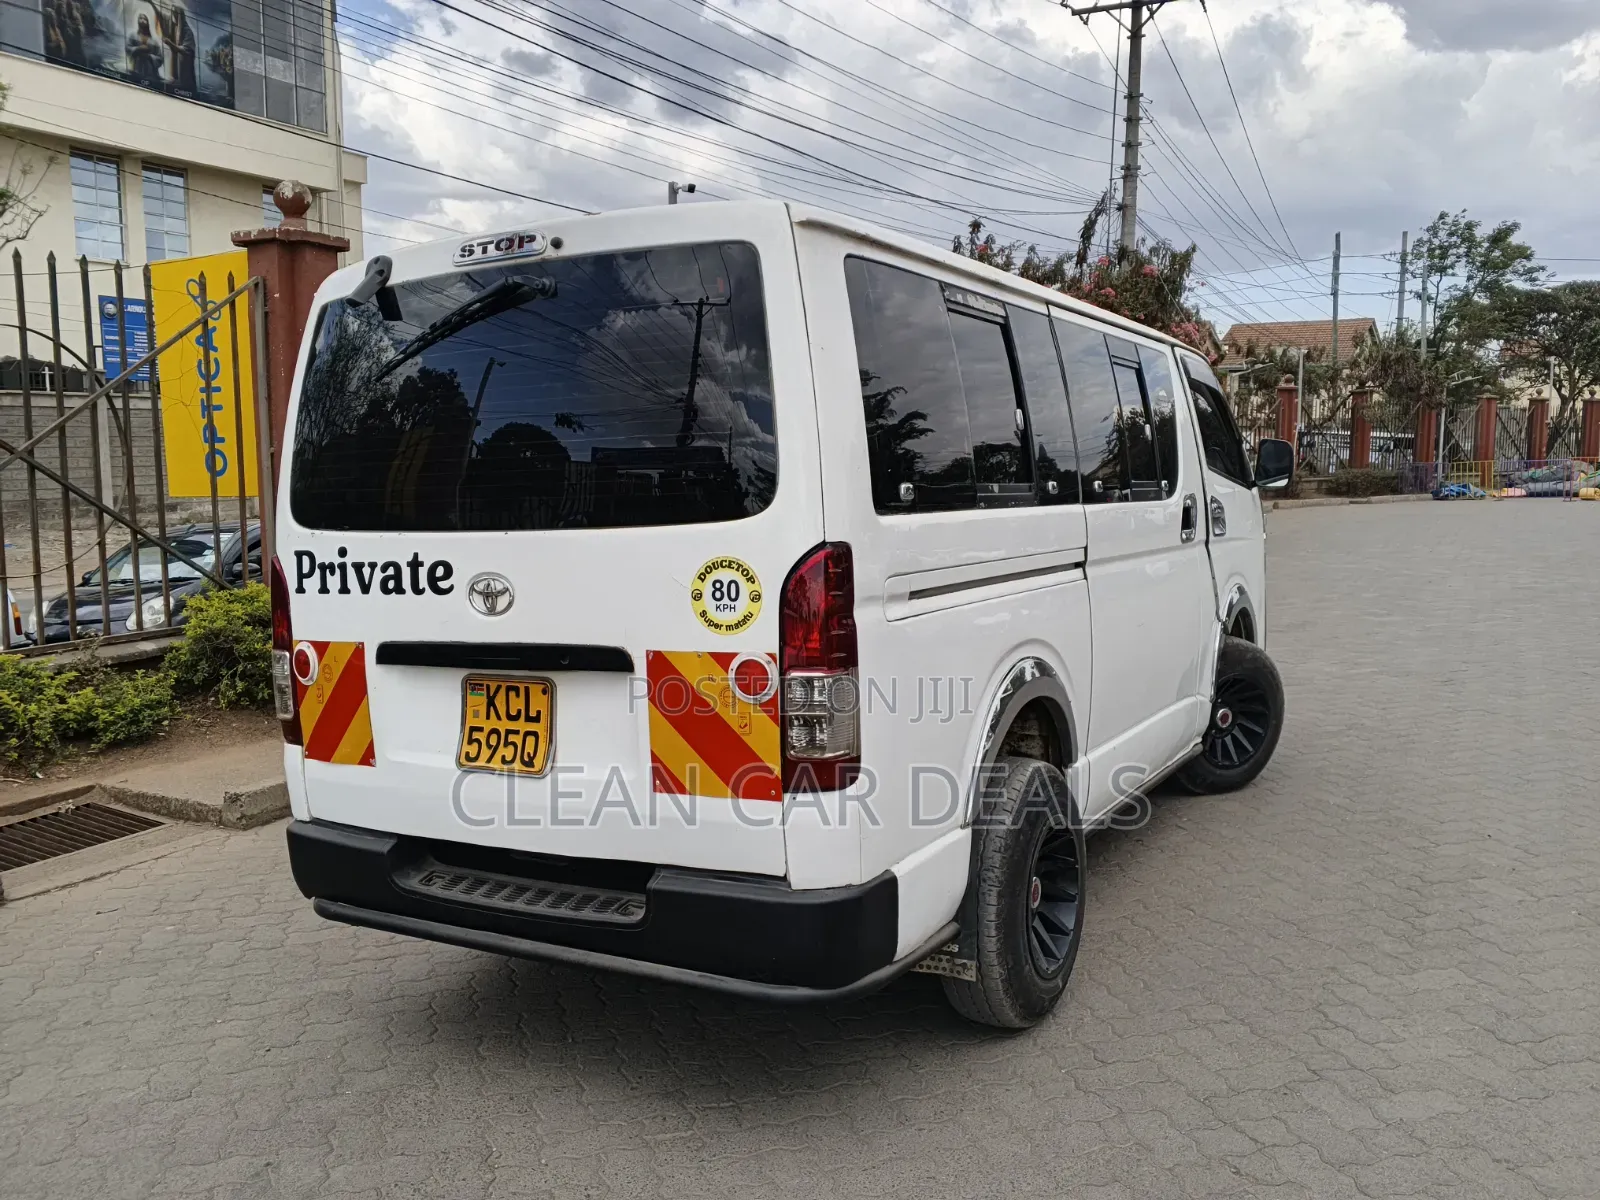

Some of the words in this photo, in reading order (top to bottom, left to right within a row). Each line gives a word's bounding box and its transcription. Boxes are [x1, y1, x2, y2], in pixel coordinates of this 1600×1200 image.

[459, 234, 537, 258] STOP
[195, 325, 228, 478] OPTICA
[294, 546, 455, 596] Private
[697, 559, 756, 585] DOUCETOP
[711, 579, 740, 602] 80
[699, 609, 724, 631] Super
[725, 611, 754, 631] matatu
[715, 604, 736, 612] KPH
[485, 683, 542, 723] KCL
[464, 725, 540, 768] 595Q
